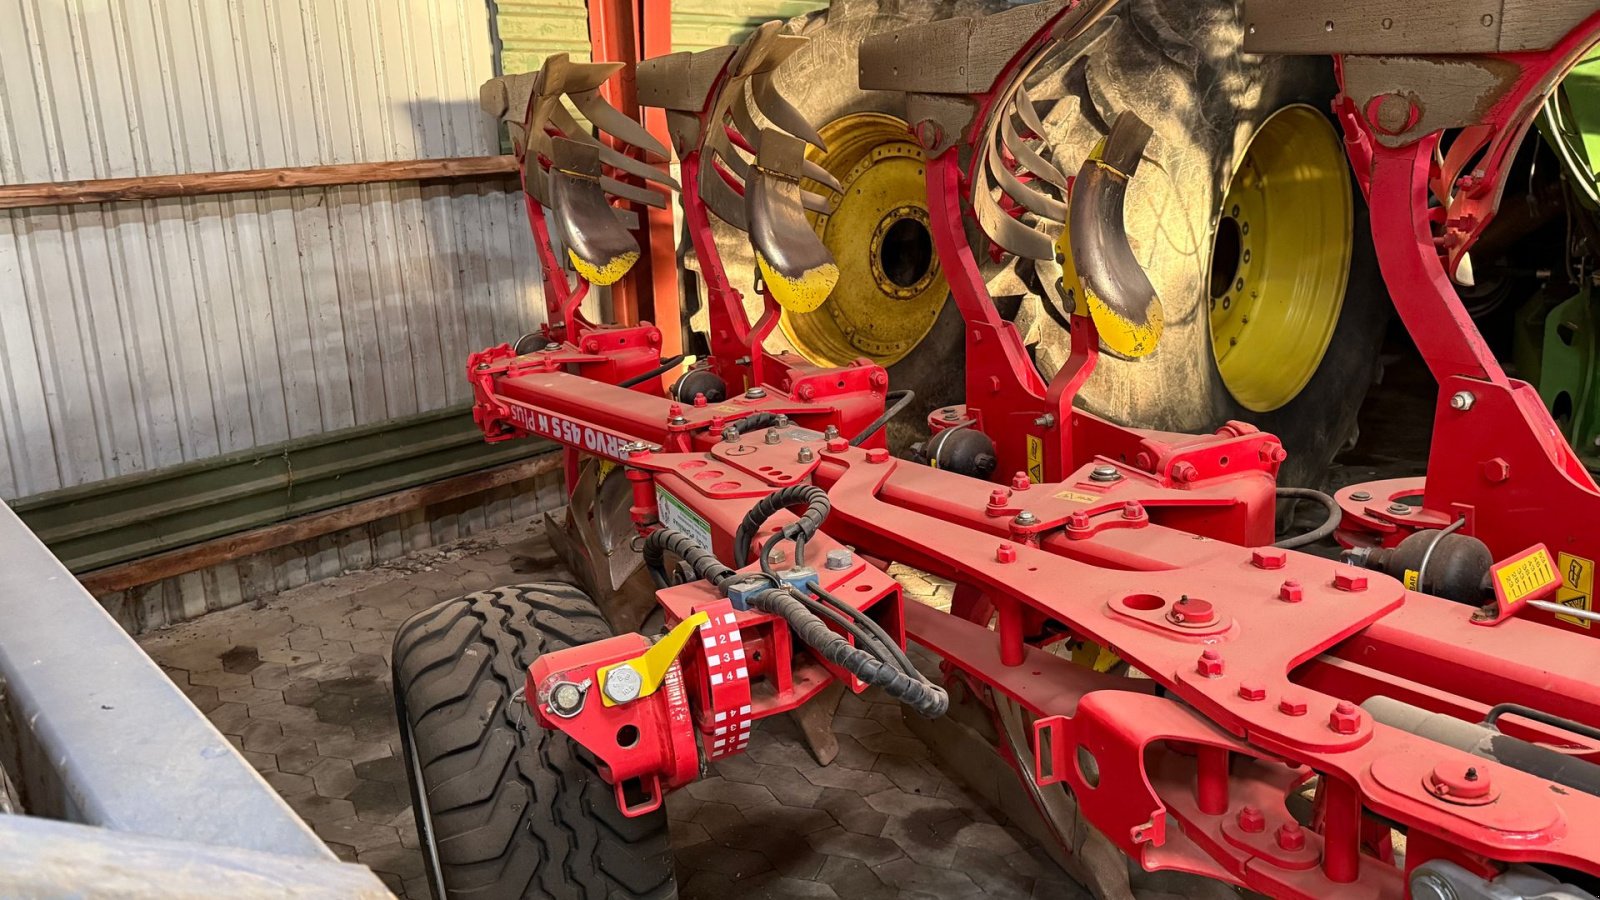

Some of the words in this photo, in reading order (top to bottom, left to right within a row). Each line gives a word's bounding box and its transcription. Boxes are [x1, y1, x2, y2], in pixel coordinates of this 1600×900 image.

[510, 404, 536, 431] Plus
[719, 634, 727, 643] 2
[723, 653, 731, 662] 3
[726, 671, 734, 681] 4
